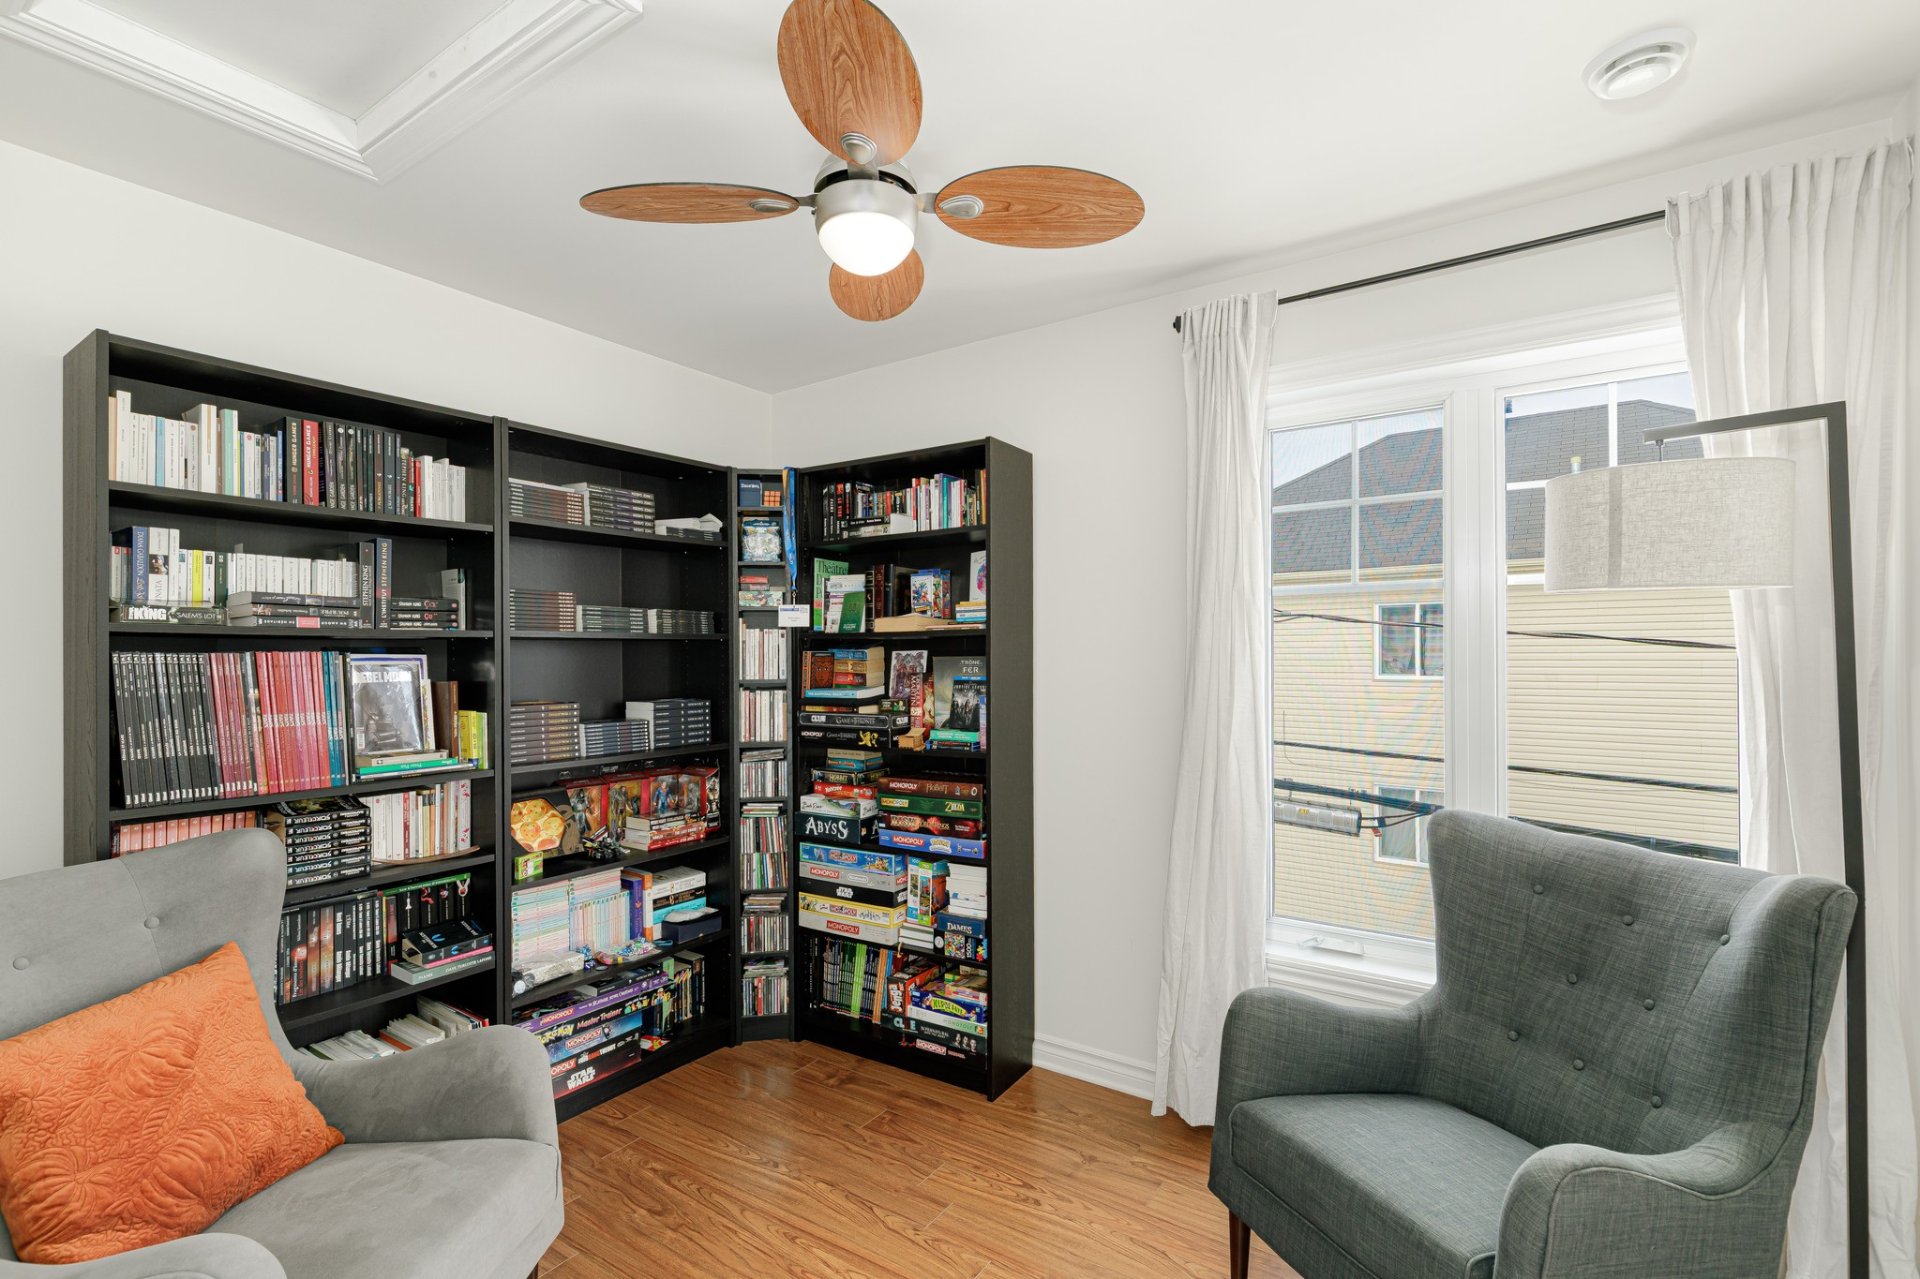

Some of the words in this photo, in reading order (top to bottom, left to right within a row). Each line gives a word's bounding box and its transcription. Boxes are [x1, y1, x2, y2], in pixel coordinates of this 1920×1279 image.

[805, 817, 849, 840] ABYSS
[893, 836, 924, 846] MONOPOLY
[811, 868, 838, 878] MONOPOLY
[828, 922, 859, 934] MONOPOLY
[540, 1008, 574, 1025] MONOPOLY
[567, 1029, 602, 1048] MONOPOLY
[551, 1061, 575, 1075] OPOLY
[570, 1067, 595, 1080] STAR
[567, 1072, 595, 1090] WARS
